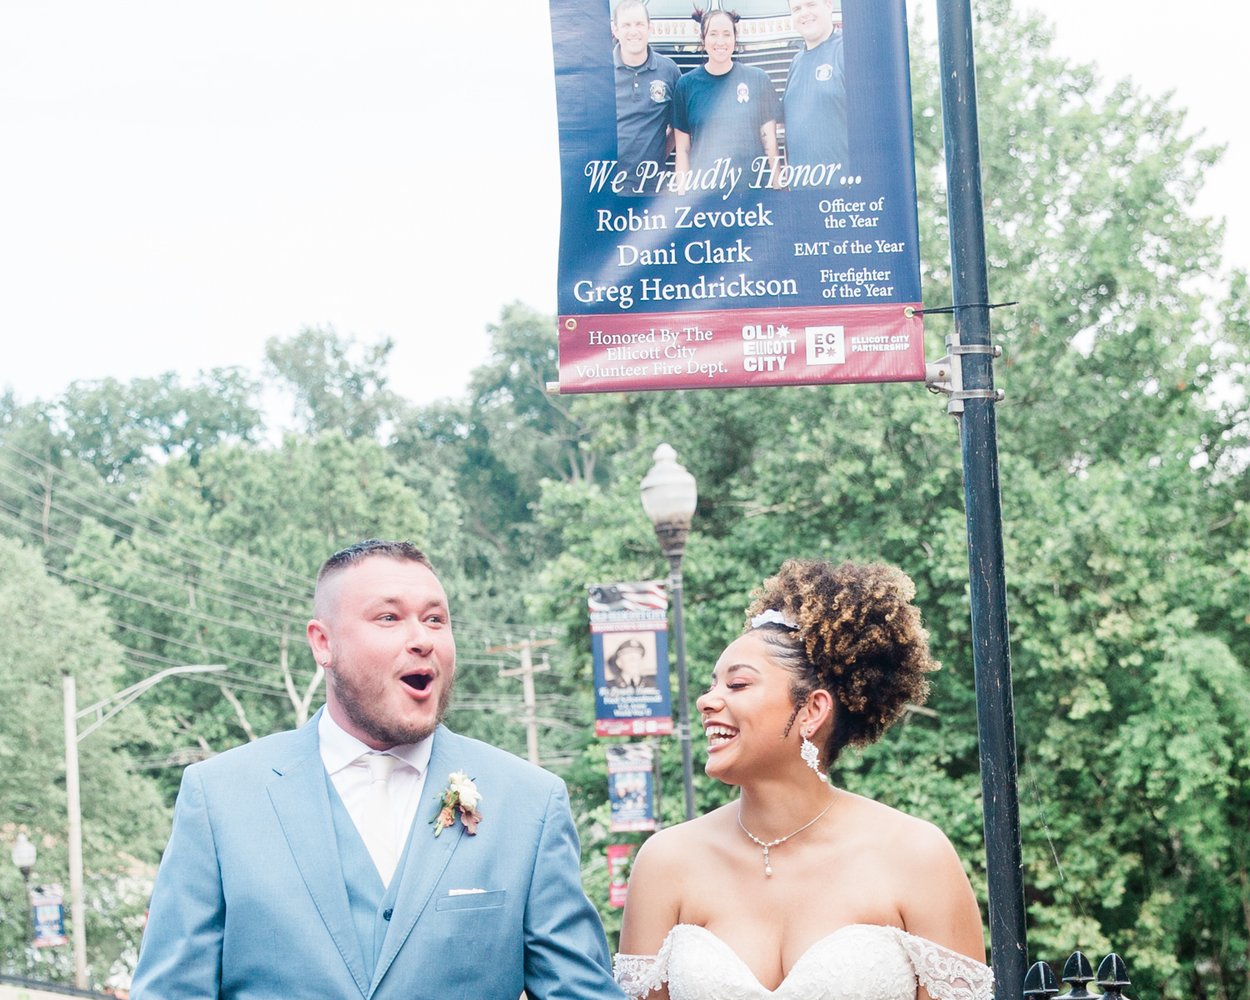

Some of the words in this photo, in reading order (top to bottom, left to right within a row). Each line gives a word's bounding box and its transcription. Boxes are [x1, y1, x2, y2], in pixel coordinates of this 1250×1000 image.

[584, 160, 627, 193] We
[632, 157, 742, 200] Proudly
[748, 155, 862, 188] Honor...
[818, 198, 866, 213] Officer
[869, 197, 884, 211] of
[596, 208, 667, 232] Robin
[674, 203, 774, 228] Zevotek
[824, 215, 846, 228] the
[848, 215, 879, 227] Year
[617, 242, 677, 267] Dani
[684, 239, 753, 264] Clark
[794, 242, 830, 256] EMT
[833, 240, 849, 254] of
[851, 240, 872, 254] the
[875, 240, 905, 253] Year
[820, 267, 891, 285] Firefighter
[573, 280, 634, 309] Greg
[640, 273, 798, 301] Hendrickson
[822, 284, 839, 298] of
[840, 285, 861, 298] the
[863, 284, 894, 297] Year
[588, 329, 655, 345] Honored
[660, 329, 680, 346] By
[683, 327, 713, 341] The
[742, 324, 774, 340] OLD
[851, 336, 889, 344] ELLICOTT
[890, 335, 910, 343] CITY
[606, 347, 660, 361] Ellicott
[664, 346, 697, 363] City
[743, 339, 797, 356] ELLICOTT
[851, 343, 910, 352] PARTNERSHIP
[575, 364, 648, 379] Volunteer
[653, 362, 682, 375] Fire
[687, 361, 728, 378] Dept.
[743, 356, 787, 372] CITY
